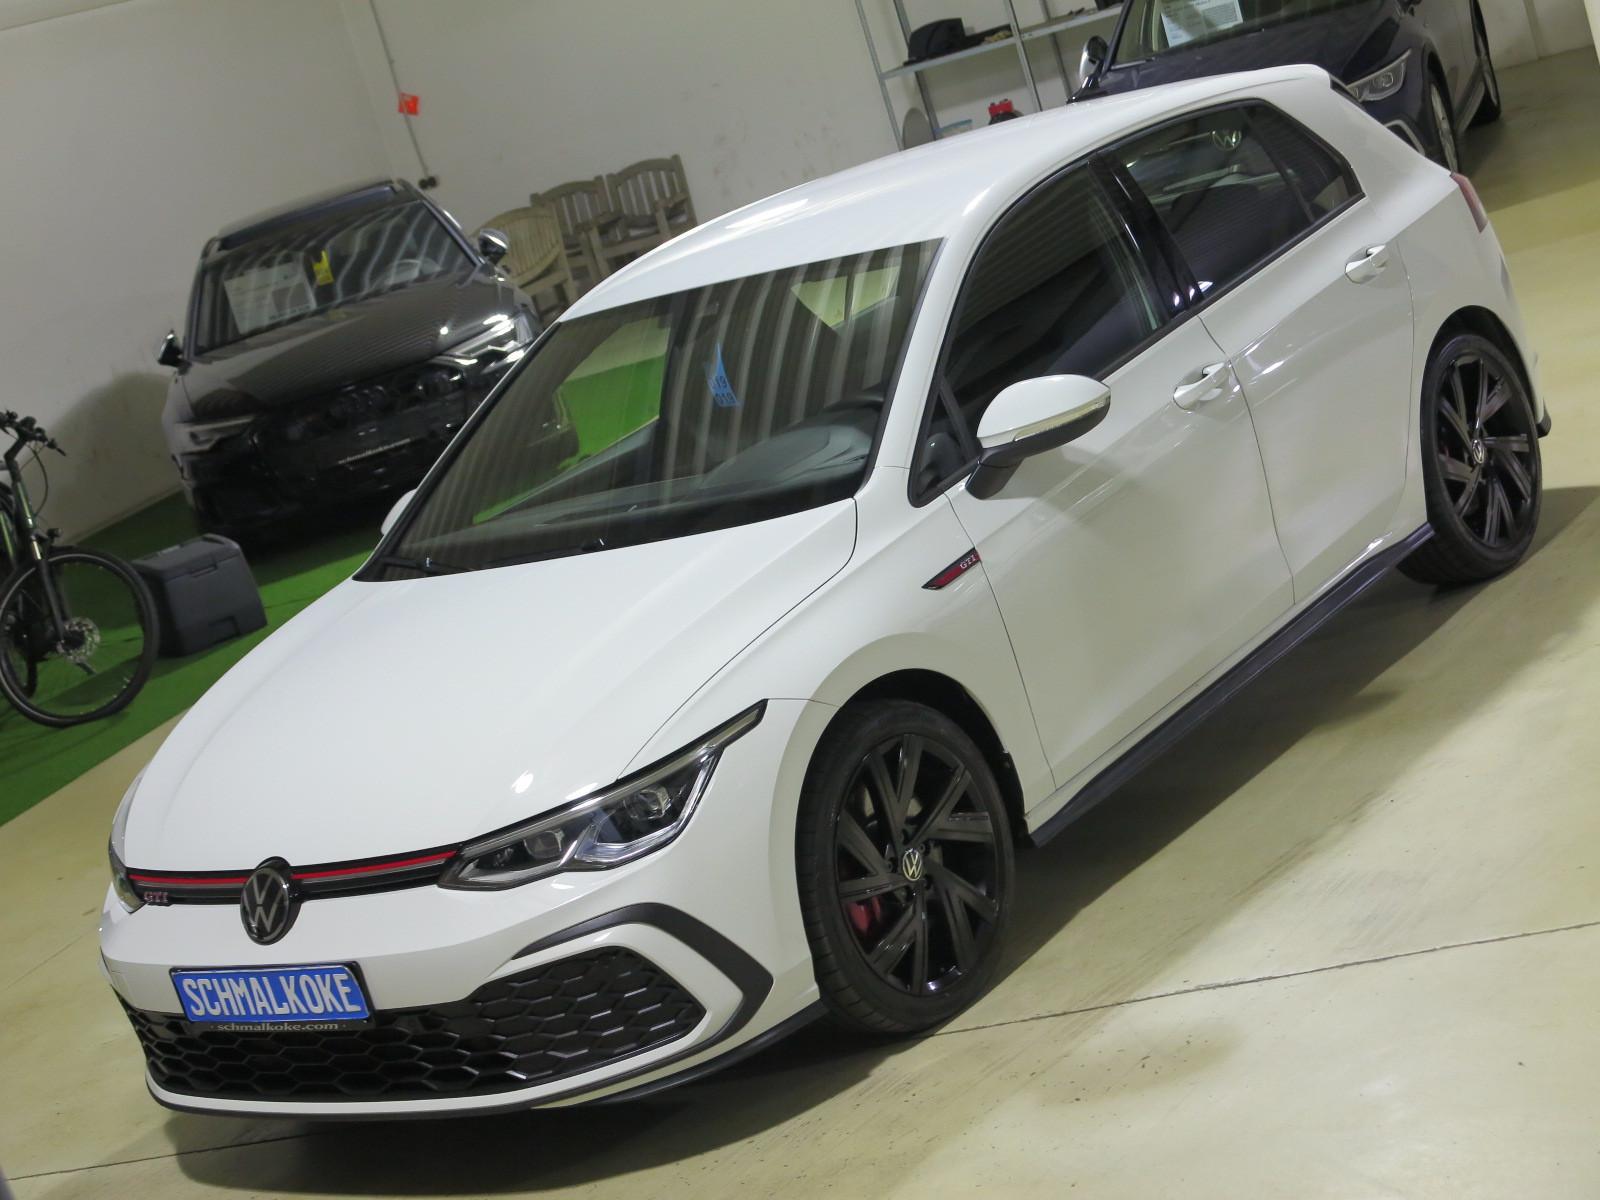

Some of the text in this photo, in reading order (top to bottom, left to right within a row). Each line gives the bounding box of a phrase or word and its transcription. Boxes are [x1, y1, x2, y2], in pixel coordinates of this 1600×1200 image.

[959, 554, 977, 569] GTI
[143, 891, 169, 903] GTI
[242, 869, 287, 936] VW
[182, 972, 361, 1017] SCHMALKOKE
[217, 1020, 339, 1032] schmalkoke.com
